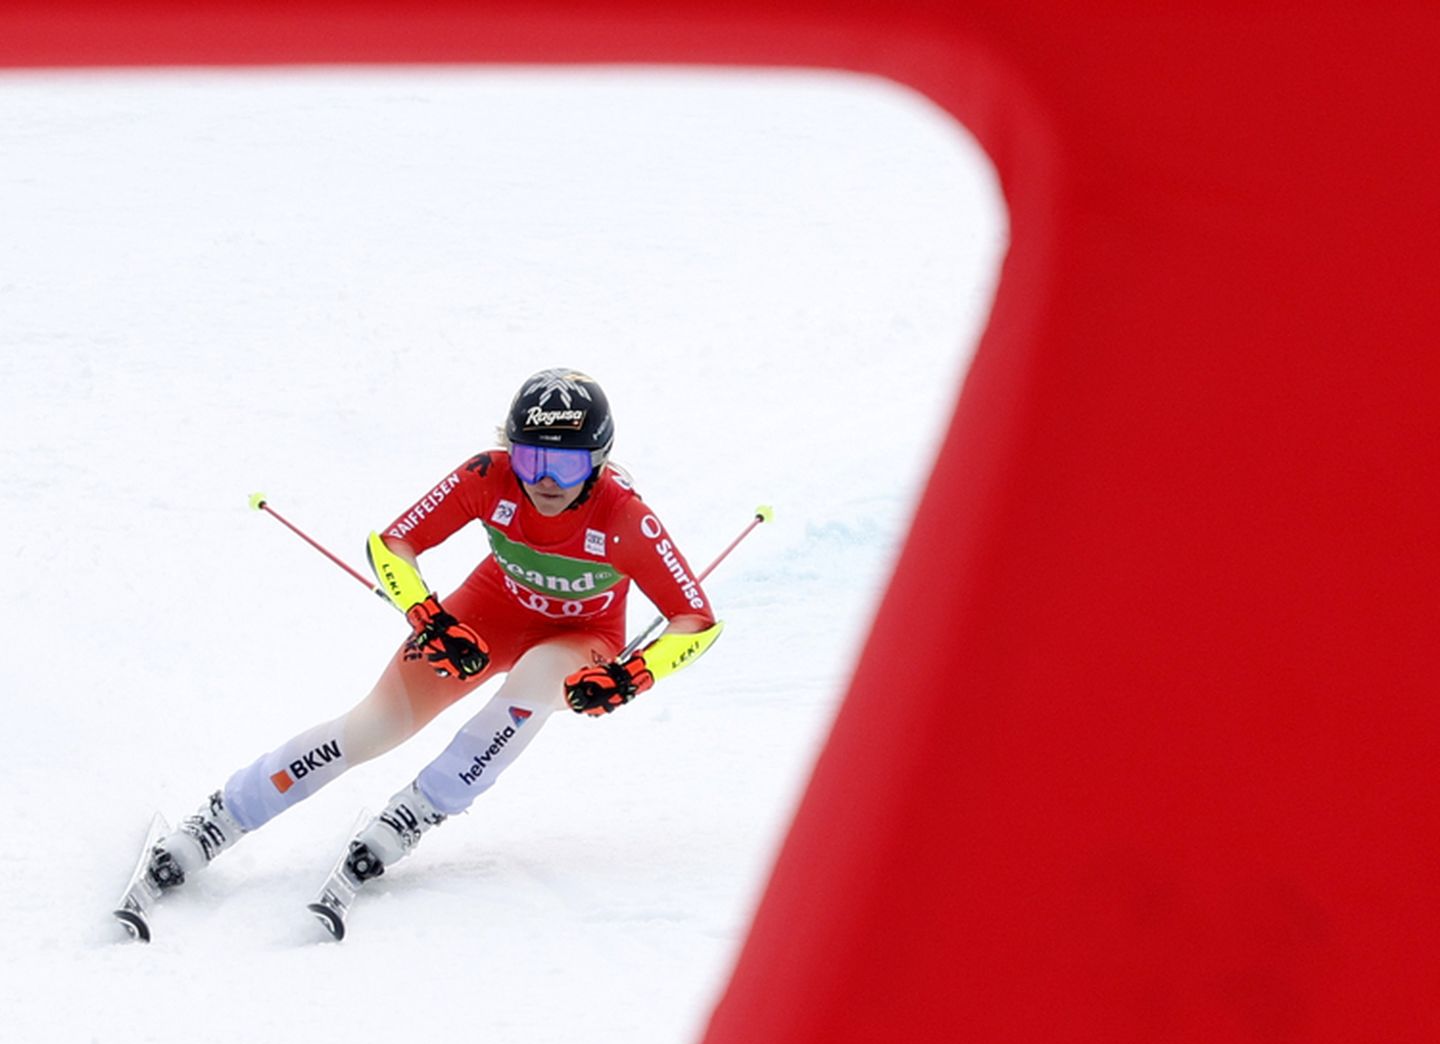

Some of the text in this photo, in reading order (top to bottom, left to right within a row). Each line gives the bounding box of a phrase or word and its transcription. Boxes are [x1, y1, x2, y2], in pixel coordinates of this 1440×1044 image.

[525, 407, 583, 426] Ragusa
[382, 563, 402, 596] LEKI
[655, 538, 704, 610] Sunrise
[671, 640, 700, 669] LEKI
[289, 739, 342, 780] BKW
[458, 725, 516, 786] helvetia
